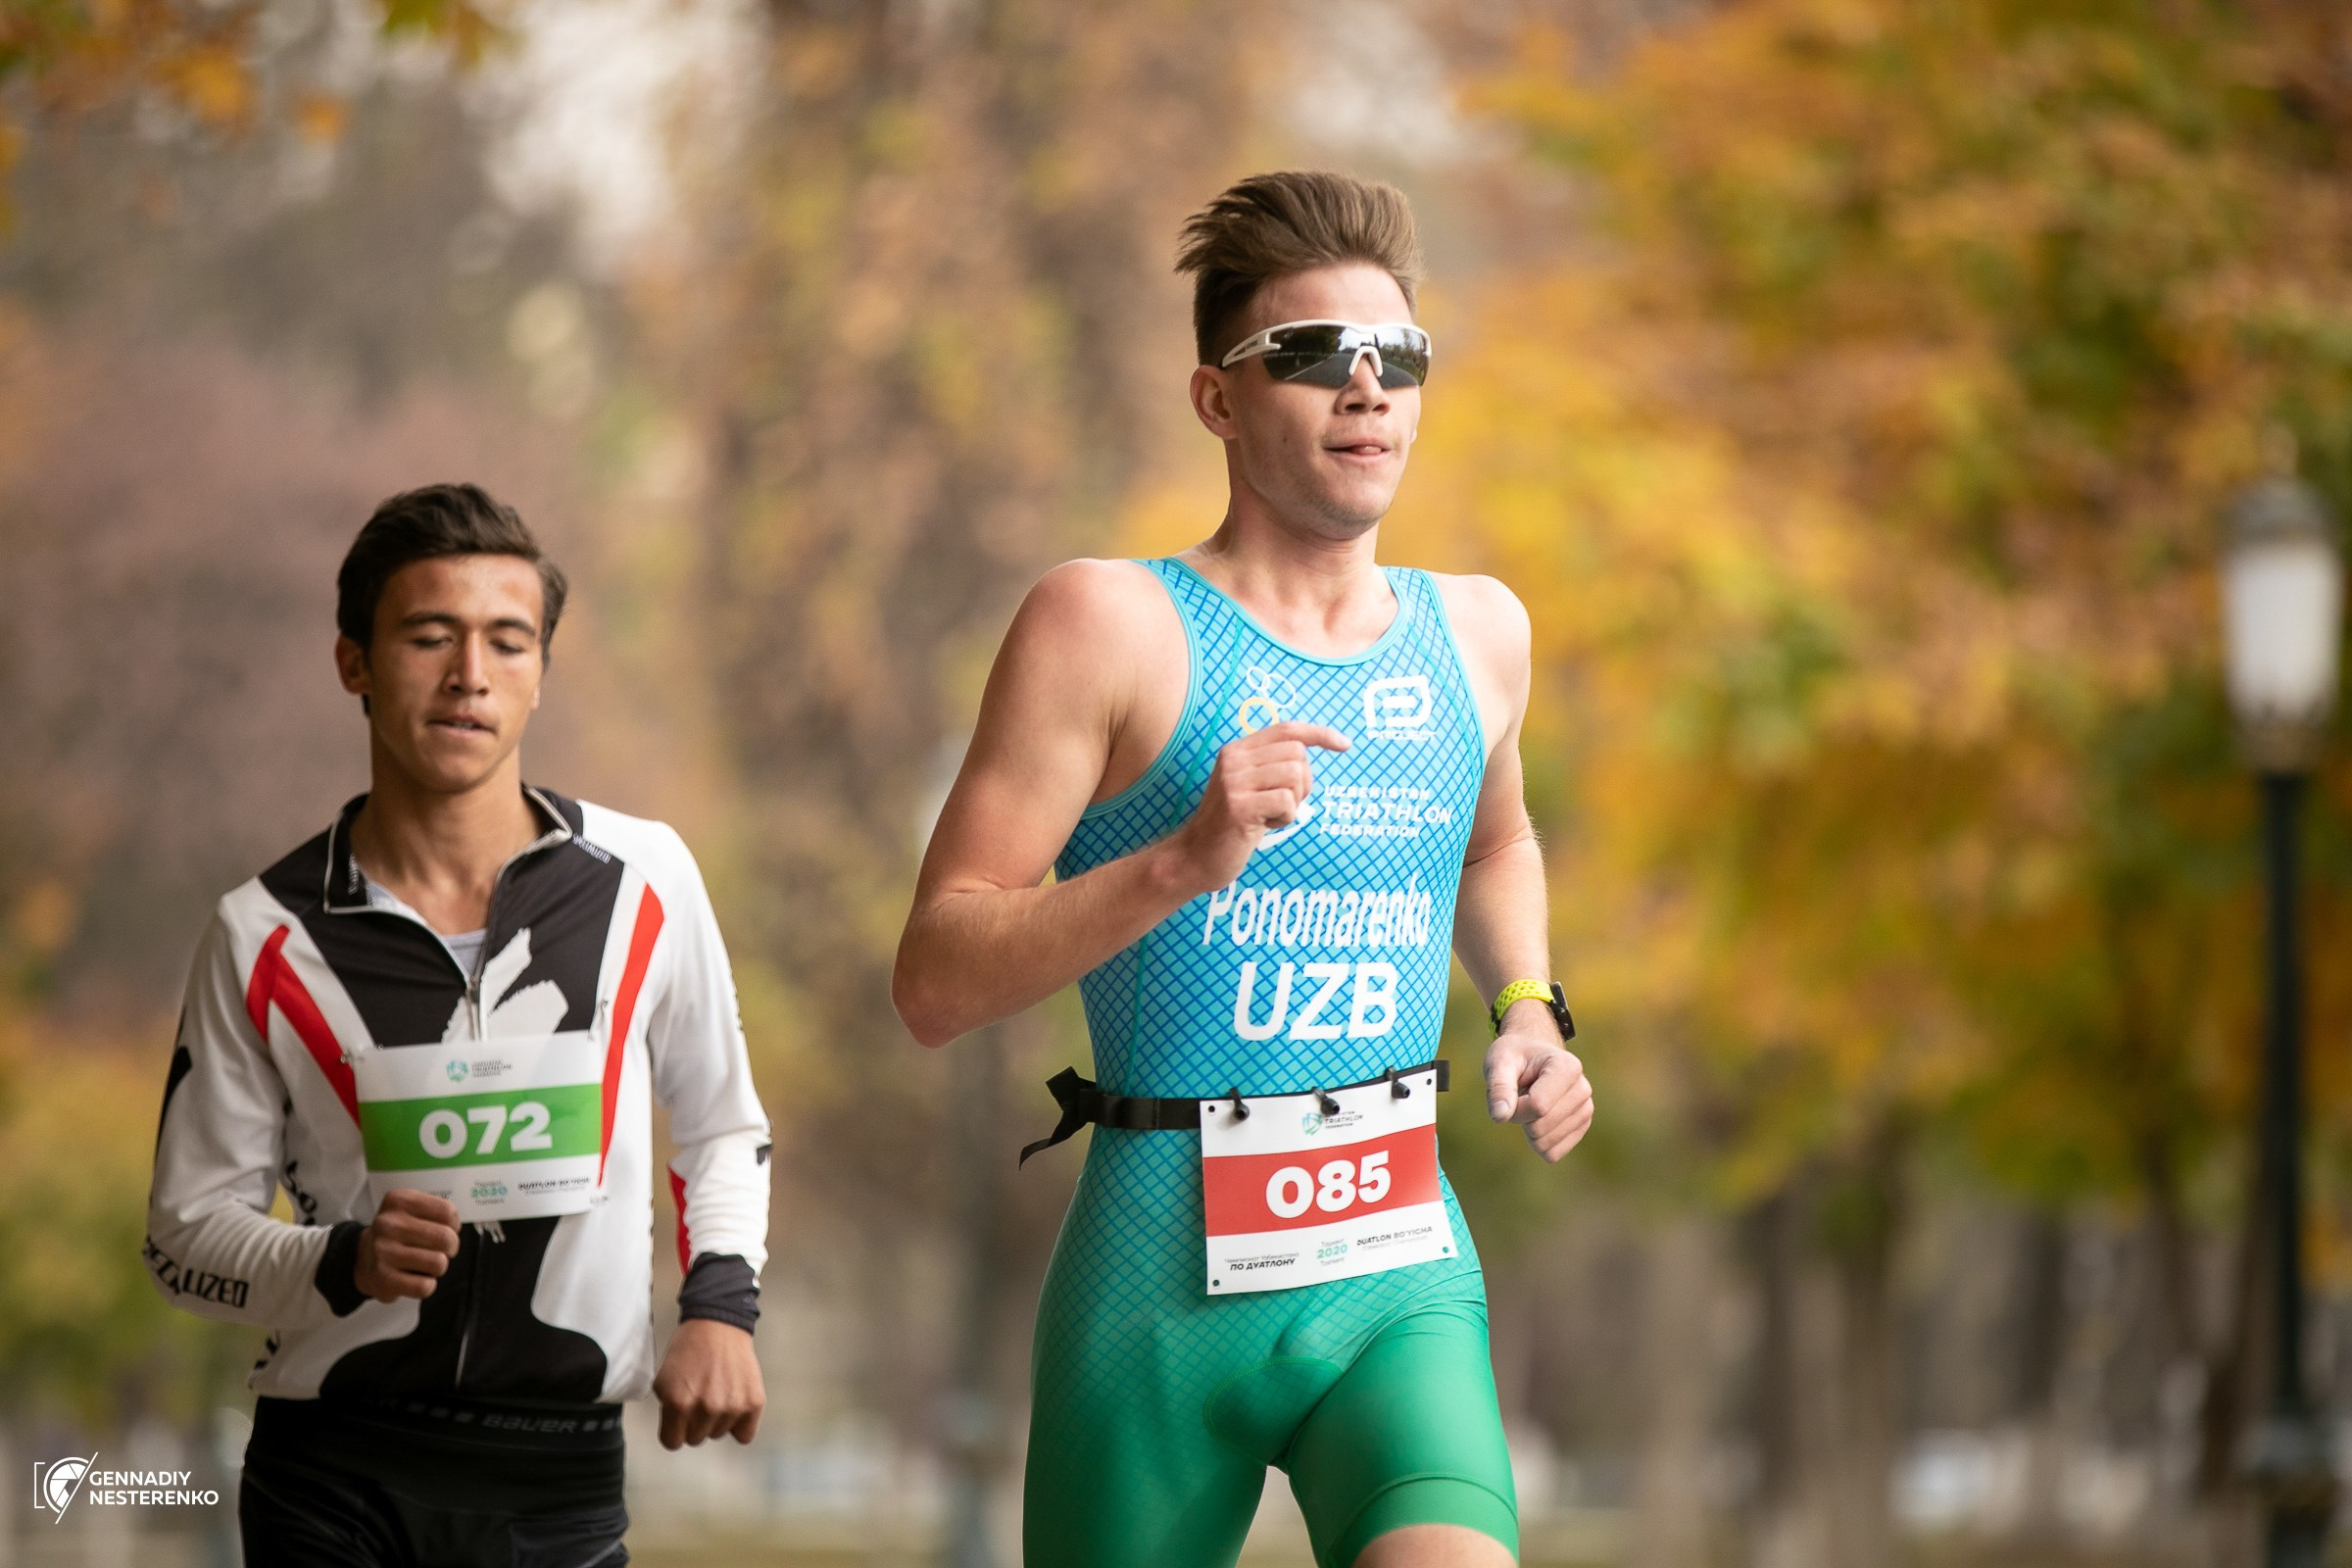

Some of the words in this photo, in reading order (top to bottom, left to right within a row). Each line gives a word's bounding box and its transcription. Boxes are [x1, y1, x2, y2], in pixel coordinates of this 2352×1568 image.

[1367, 730, 1436, 742] PROJECT
[1323, 785, 1430, 801] UZBEKISTAN
[1322, 801, 1452, 824] TRIATHLON
[1319, 822, 1420, 838] FEDERATION
[1202, 871, 1432, 948] Ponomarenko
[1233, 960, 1398, 1042] UZB
[418, 1101, 553, 1160] 072
[1265, 1150, 1392, 1219] 085
[1356, 1233, 1392, 1247] DUATLON
[1316, 1243, 1348, 1259] 2020
[1230, 1262, 1245, 1271] ПО
[1246, 1257, 1297, 1271] ДУАТЛОНУ
